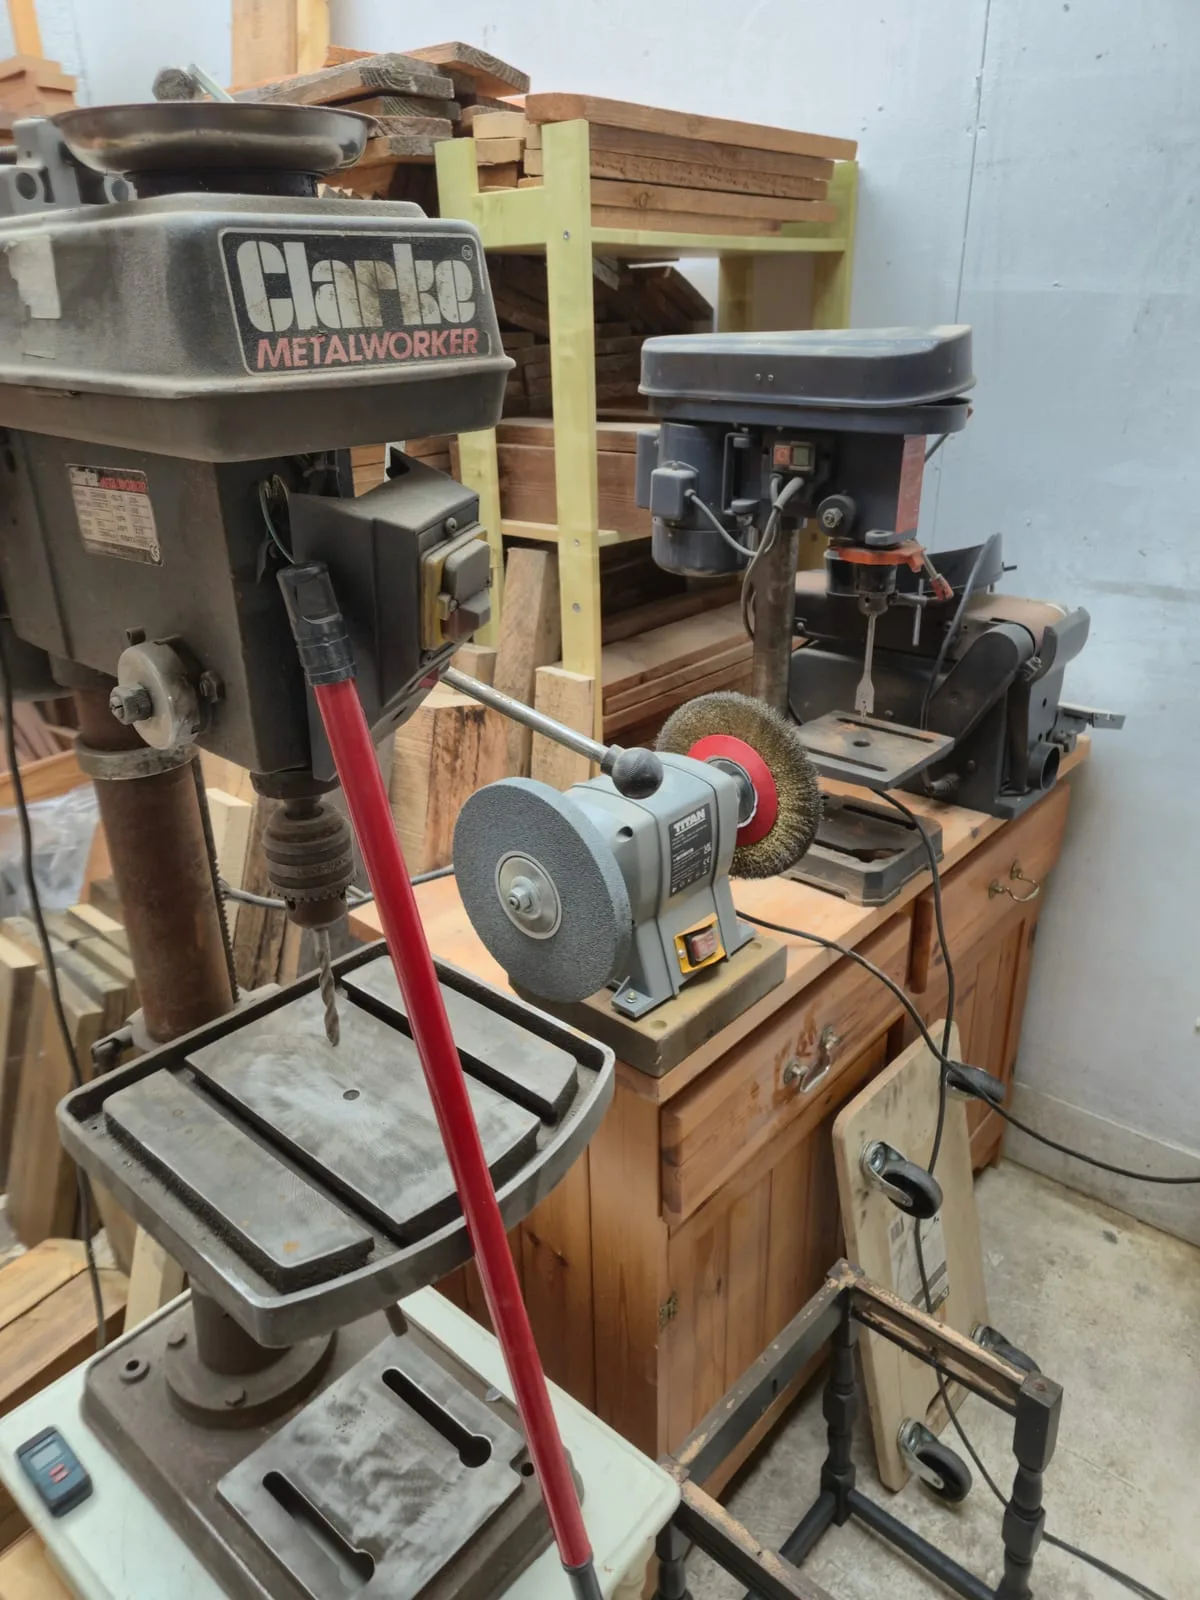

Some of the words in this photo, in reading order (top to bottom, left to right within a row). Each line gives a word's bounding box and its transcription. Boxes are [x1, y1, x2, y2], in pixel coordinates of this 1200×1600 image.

[237, 240, 476, 332] Clarke
[256, 328, 479, 369] METALWORKER
[673, 808, 706, 833] TITAN
